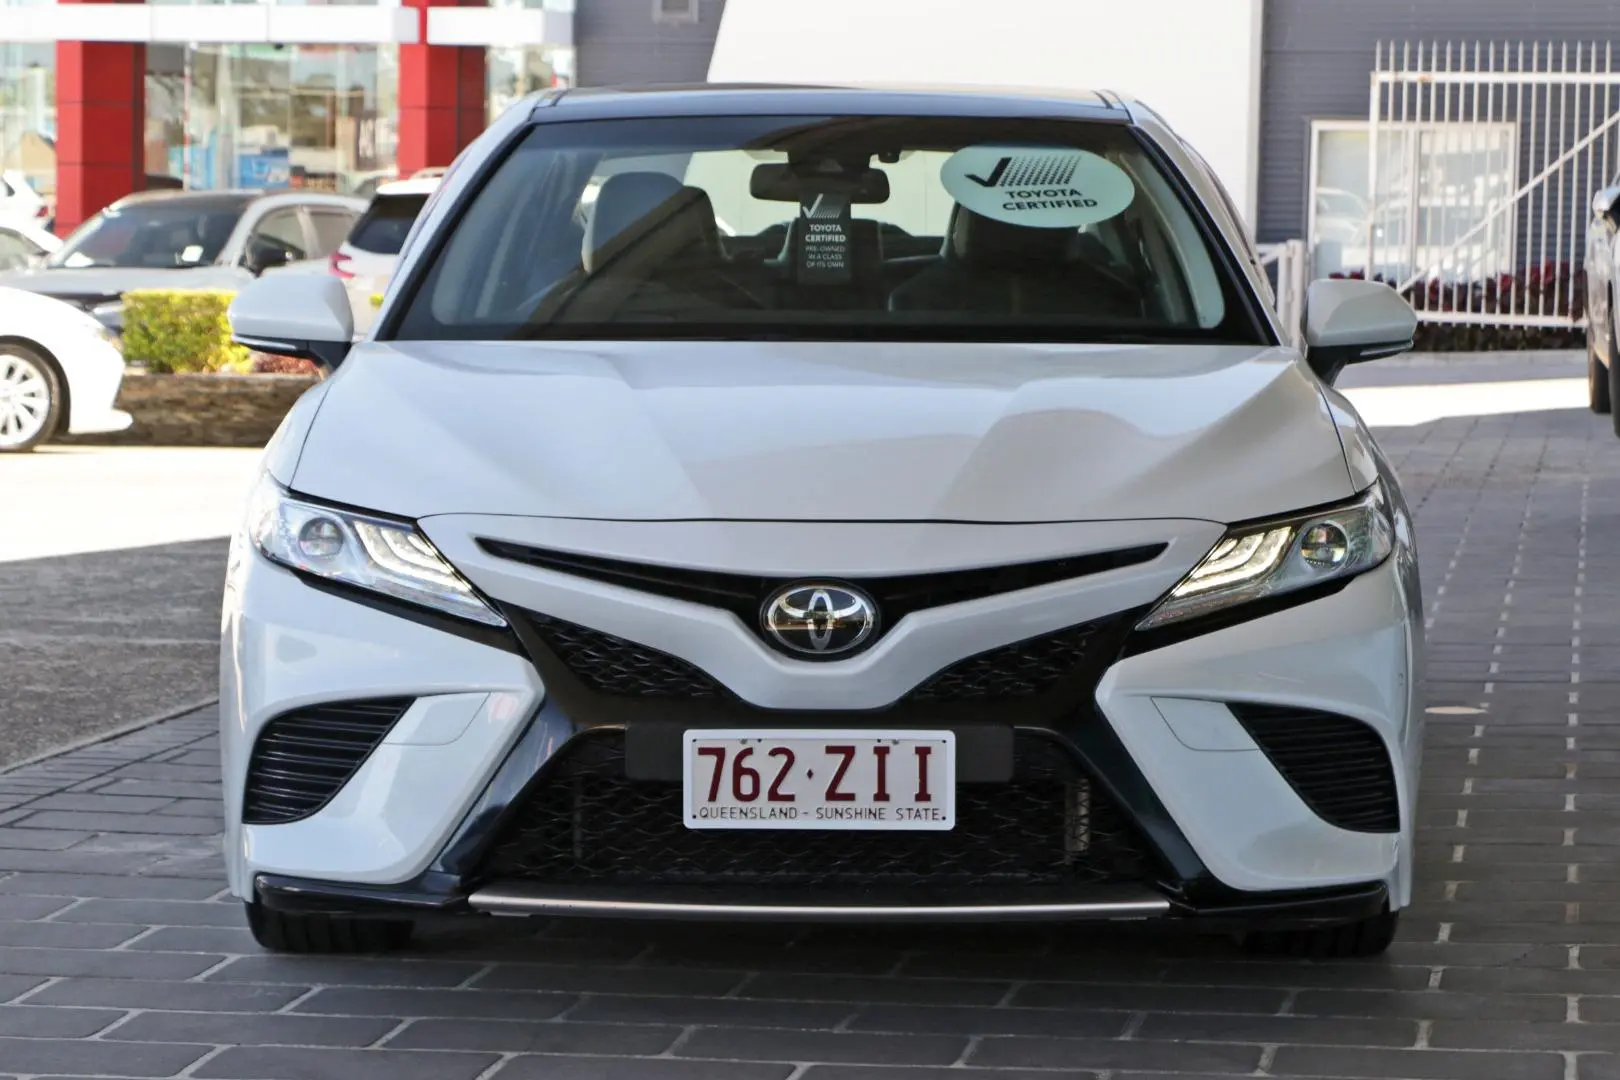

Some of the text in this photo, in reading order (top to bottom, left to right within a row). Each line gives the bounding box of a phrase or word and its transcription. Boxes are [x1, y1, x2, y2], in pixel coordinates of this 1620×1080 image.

[1005, 188, 1082, 199] TOYOTA
[1002, 199, 1098, 211] CERTIFIED
[809, 224, 842, 232] TOYOTA
[805, 234, 846, 242] CERTIFIED
[699, 806, 798, 819] QUEENSLAND
[816, 807, 886, 820] SUNSHINE
[896, 807, 940, 820] STATE
